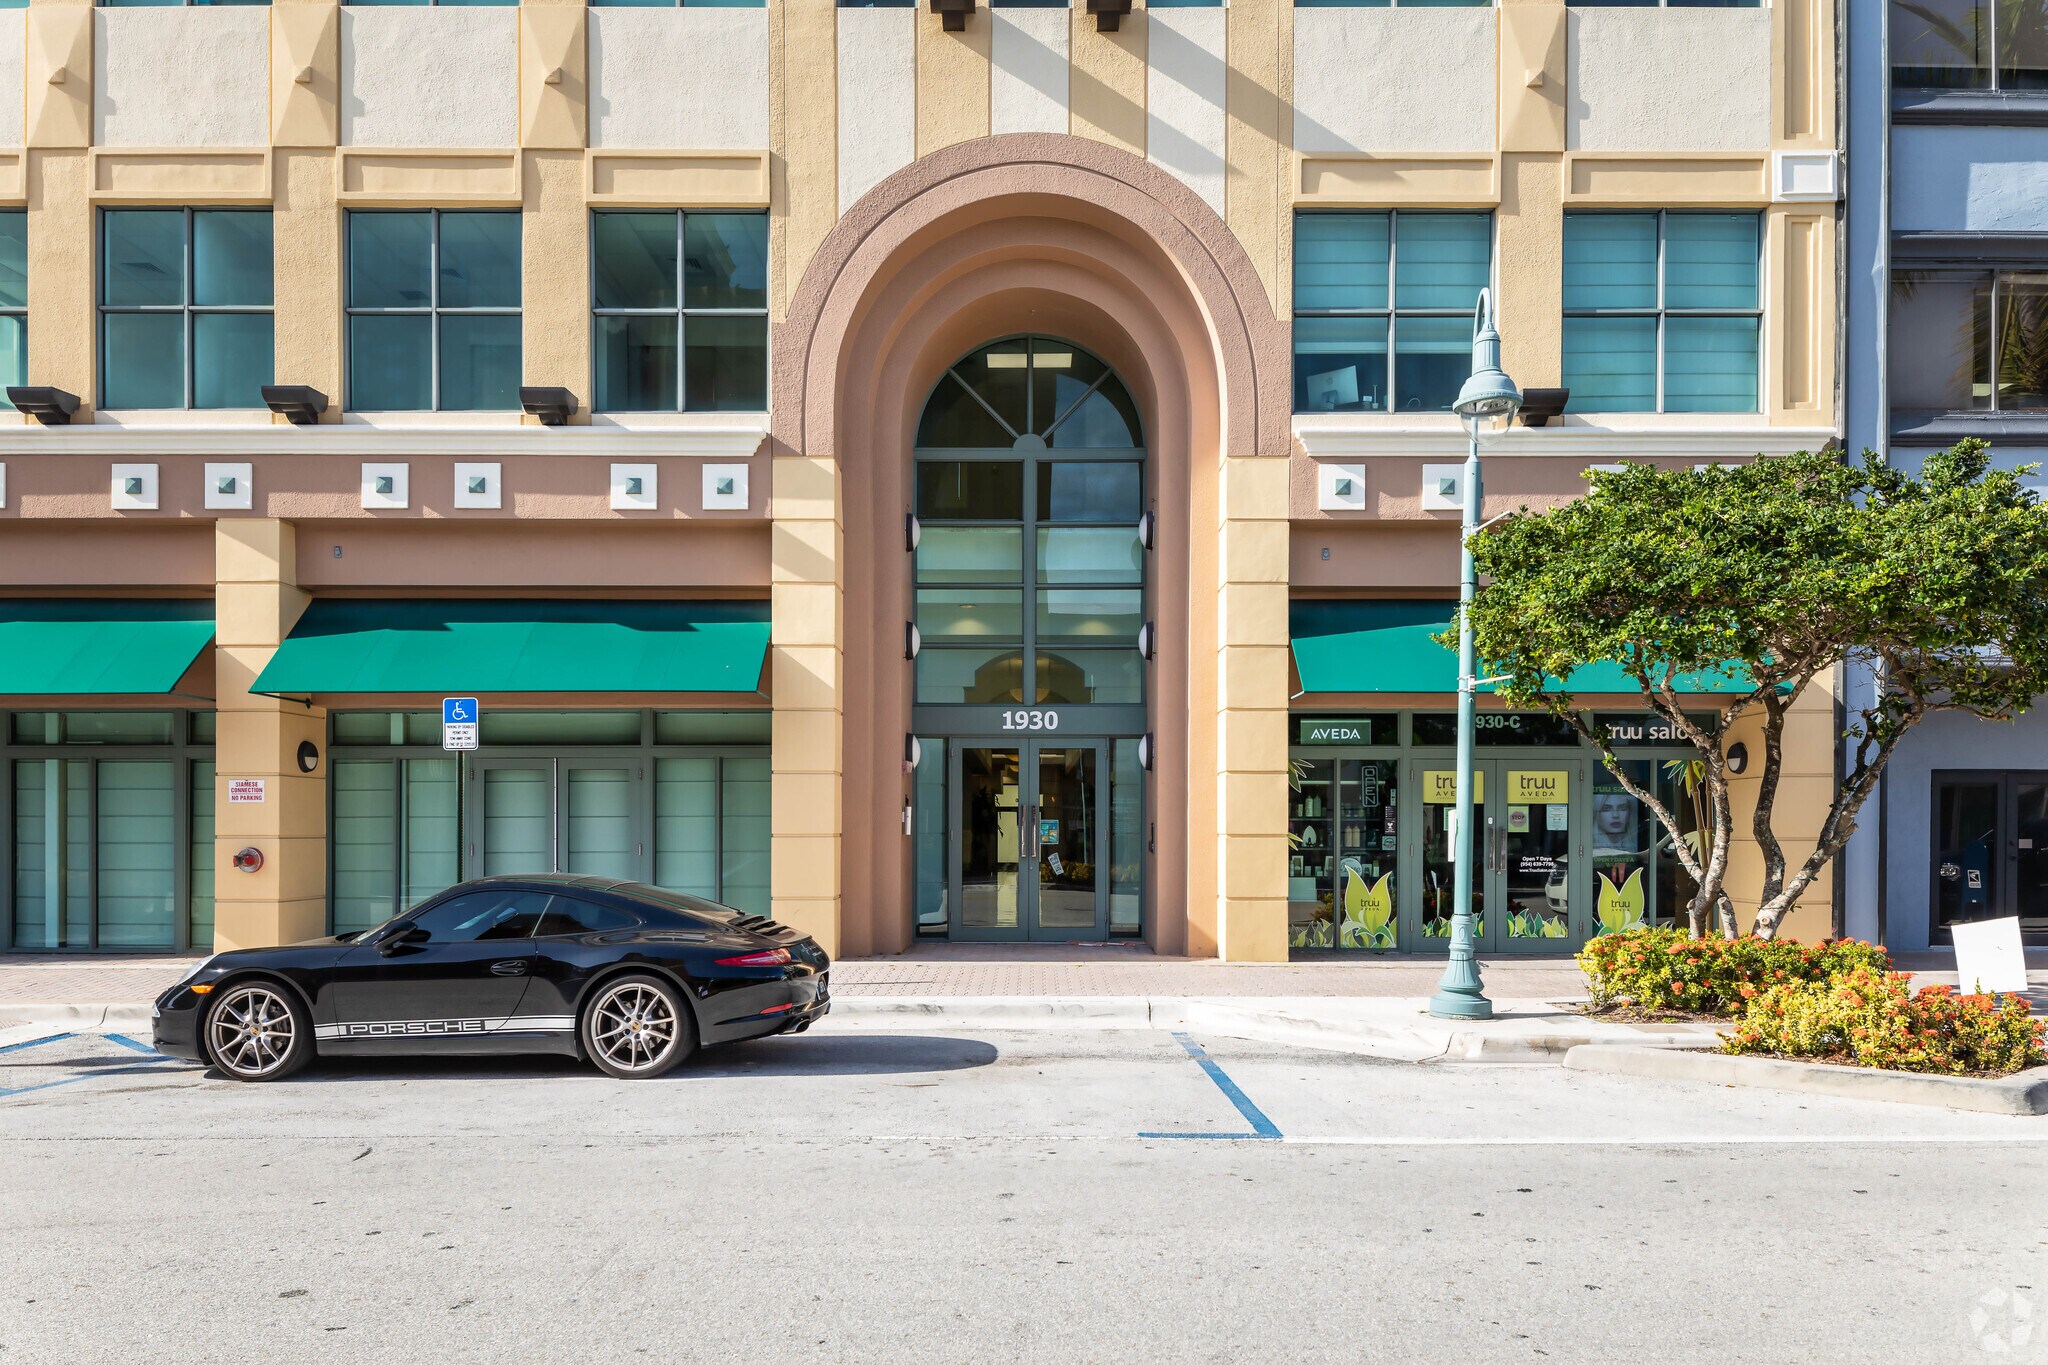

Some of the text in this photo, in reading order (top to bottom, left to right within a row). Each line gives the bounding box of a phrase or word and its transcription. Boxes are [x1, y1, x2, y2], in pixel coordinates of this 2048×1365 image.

[1002, 710, 1059, 730] 1930
[1475, 715, 1521, 729] 930-C
[1310, 728, 1361, 740] AVEDA
[1648, 723, 1690, 740] salo
[1364, 768, 1377, 805] OPEN
[1435, 774, 1457, 789] tru
[1520, 774, 1555, 789] truu
[1360, 898, 1379, 907] truu
[1611, 899, 1630, 908] truu
[350, 1020, 483, 1035] PORSCHE
